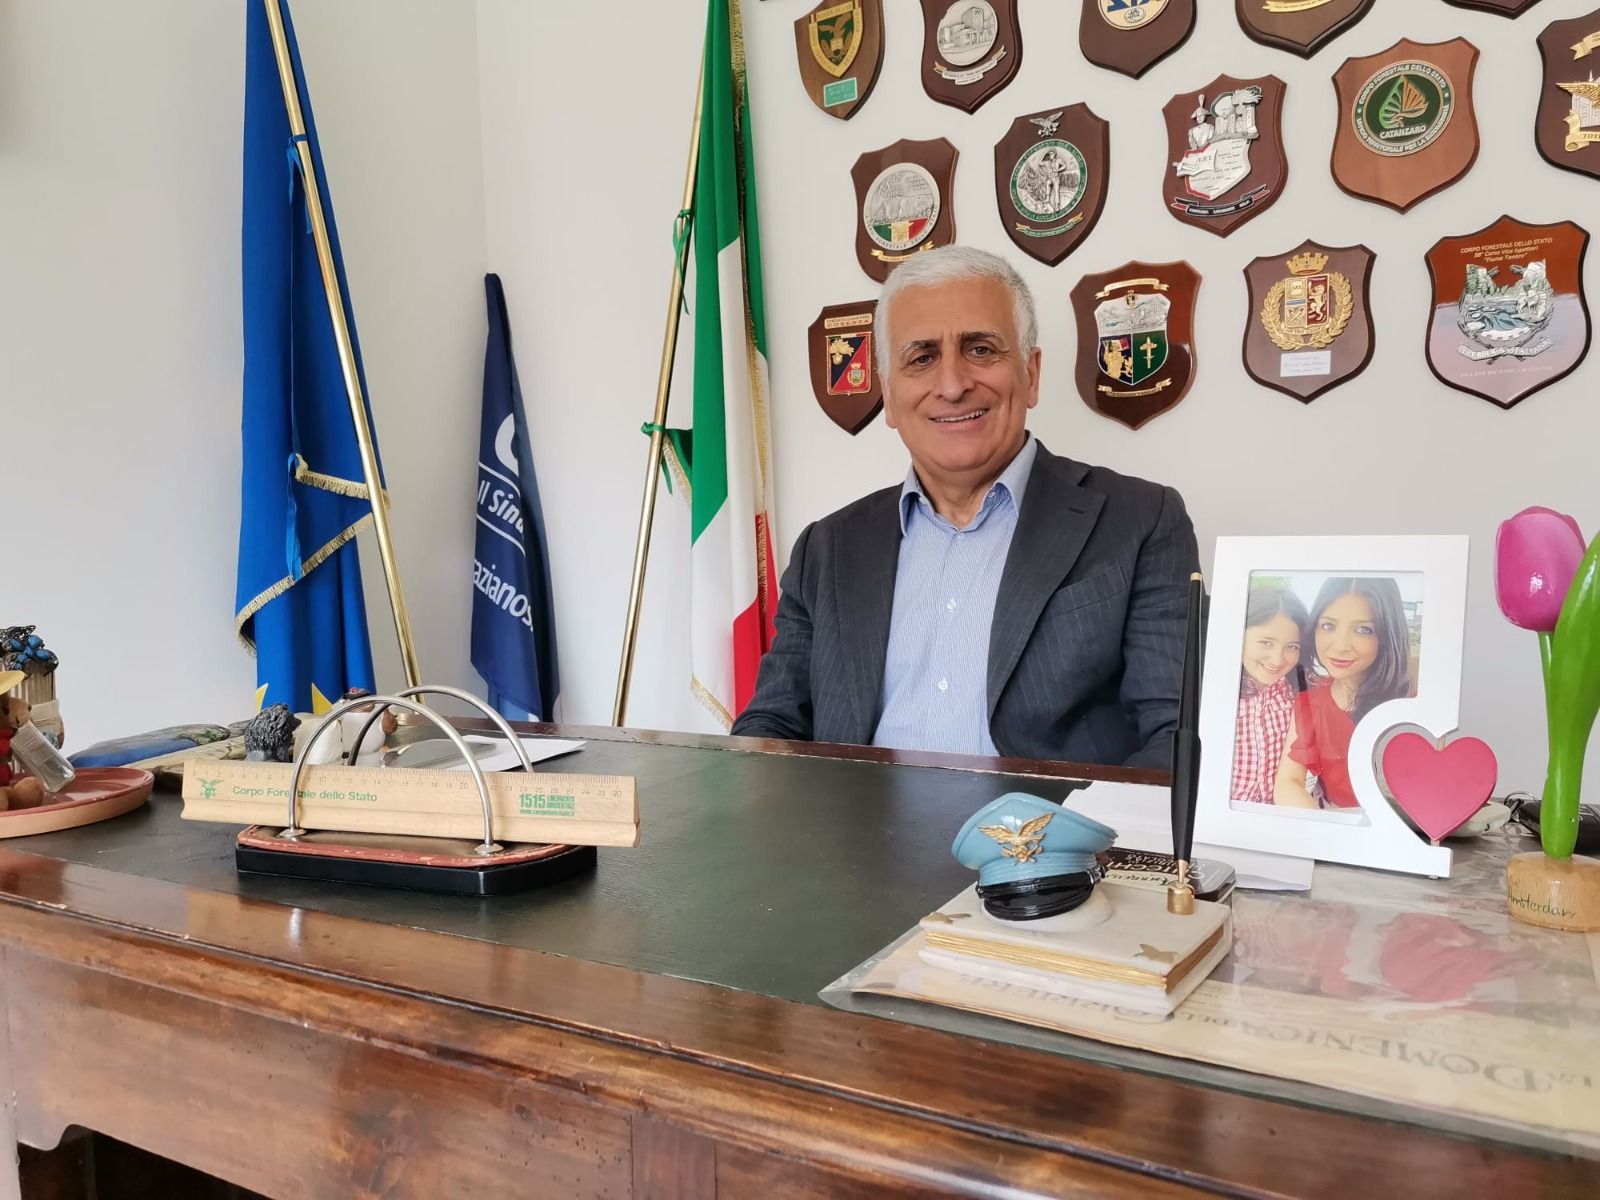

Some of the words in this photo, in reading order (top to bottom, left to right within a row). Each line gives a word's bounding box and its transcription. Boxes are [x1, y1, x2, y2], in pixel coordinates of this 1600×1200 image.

[1359, 82, 1374, 104] CORPO
[1374, 64, 1410, 84] FORESTALE
[1410, 64, 1431, 75] DELLO
[1431, 70, 1446, 88] STATO
[1379, 124, 1426, 139] CATANZARO
[1514, 239, 1532, 248] DELLO
[1533, 237, 1553, 245] STATO
[232, 785, 264, 797] Corpo
[266, 787, 317, 799] Foretale
[319, 790, 345, 800] dello
[348, 791, 378, 802] Stato
[519, 793, 546, 809] 1515
